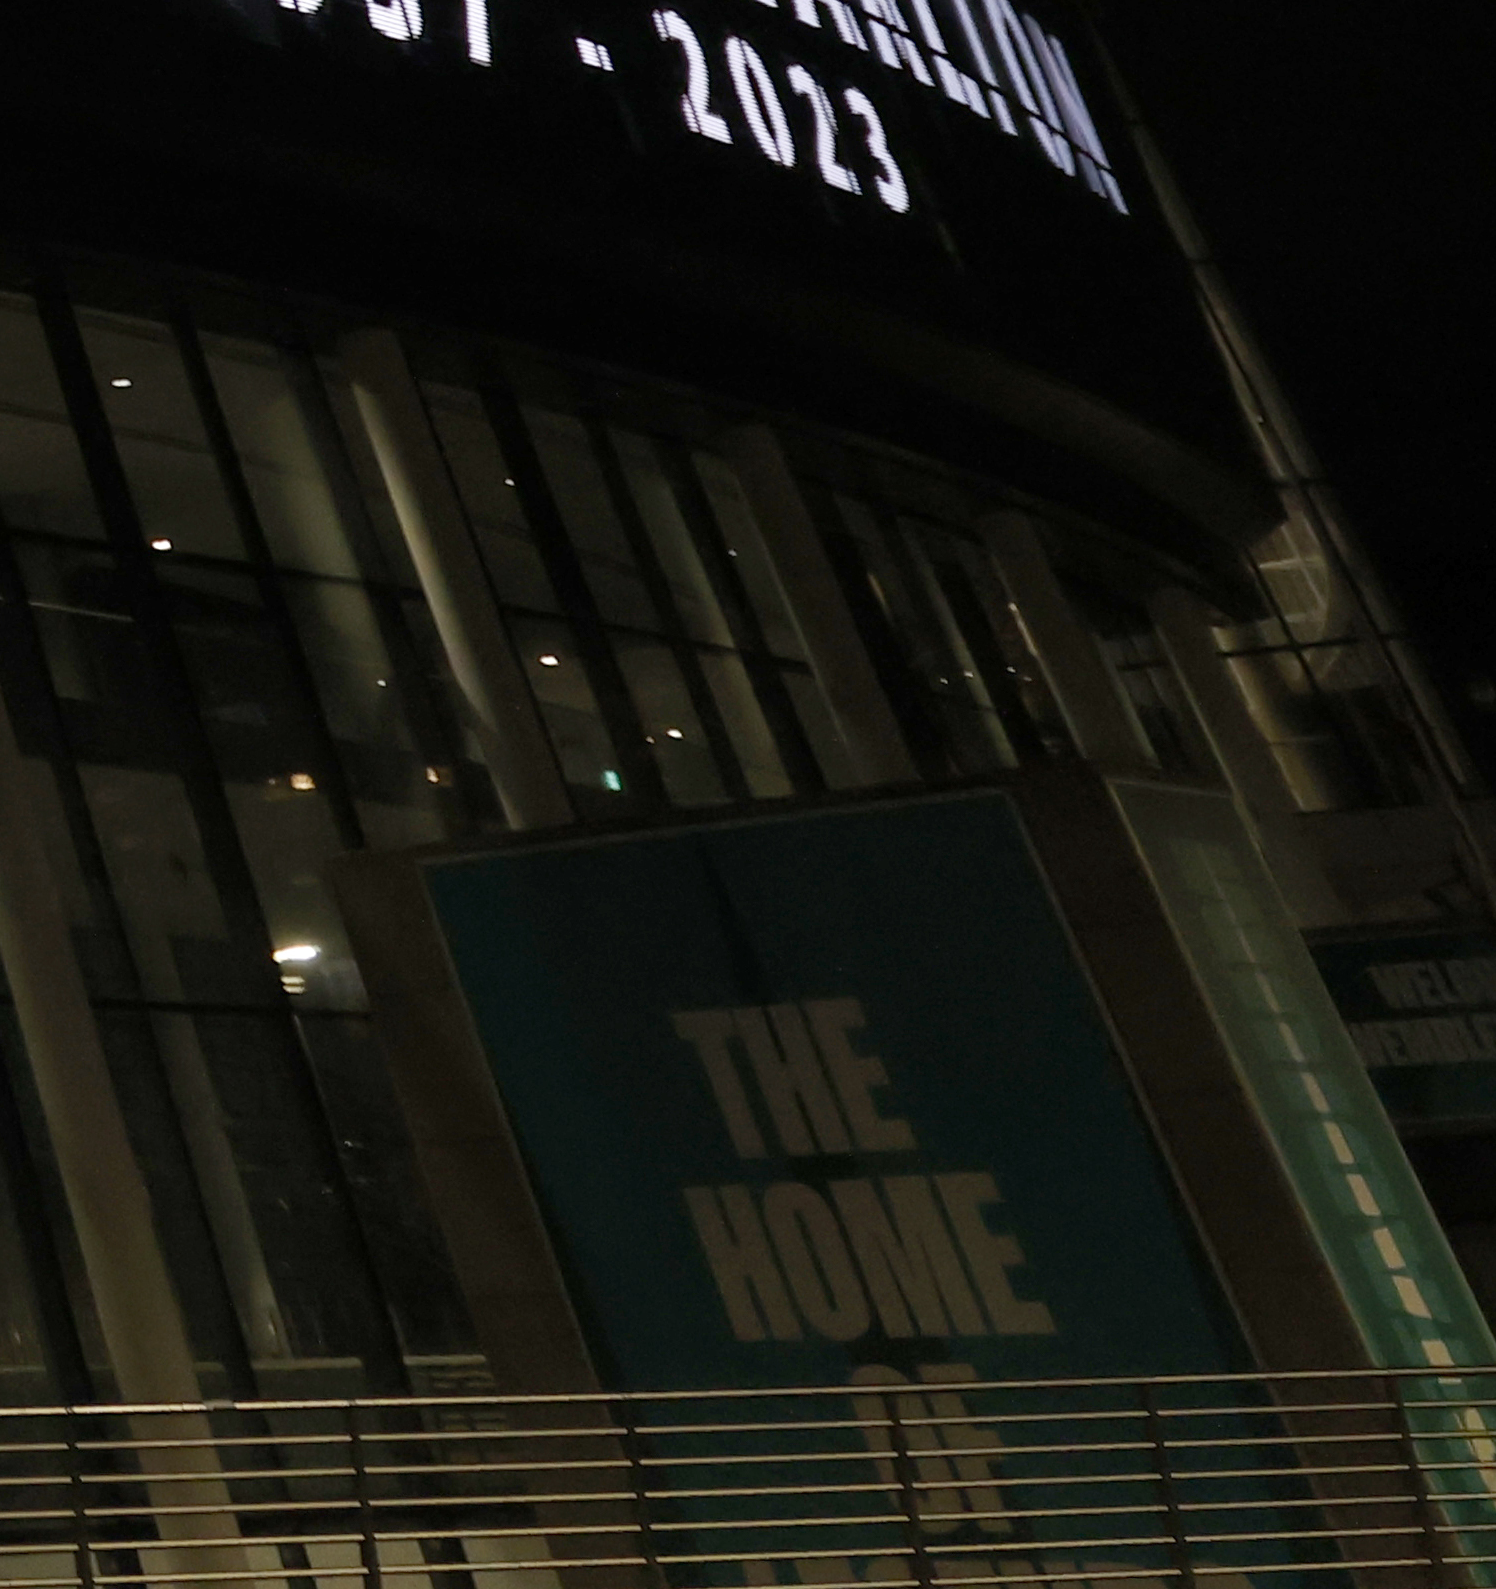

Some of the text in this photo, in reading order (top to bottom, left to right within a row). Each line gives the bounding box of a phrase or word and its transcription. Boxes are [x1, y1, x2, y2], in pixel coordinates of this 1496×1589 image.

[652, 9, 910, 214] 2023
[670, 996, 922, 1159] THE
[682, 1171, 1058, 1342] HOME
[850, 1363, 1012, 1533] OF
